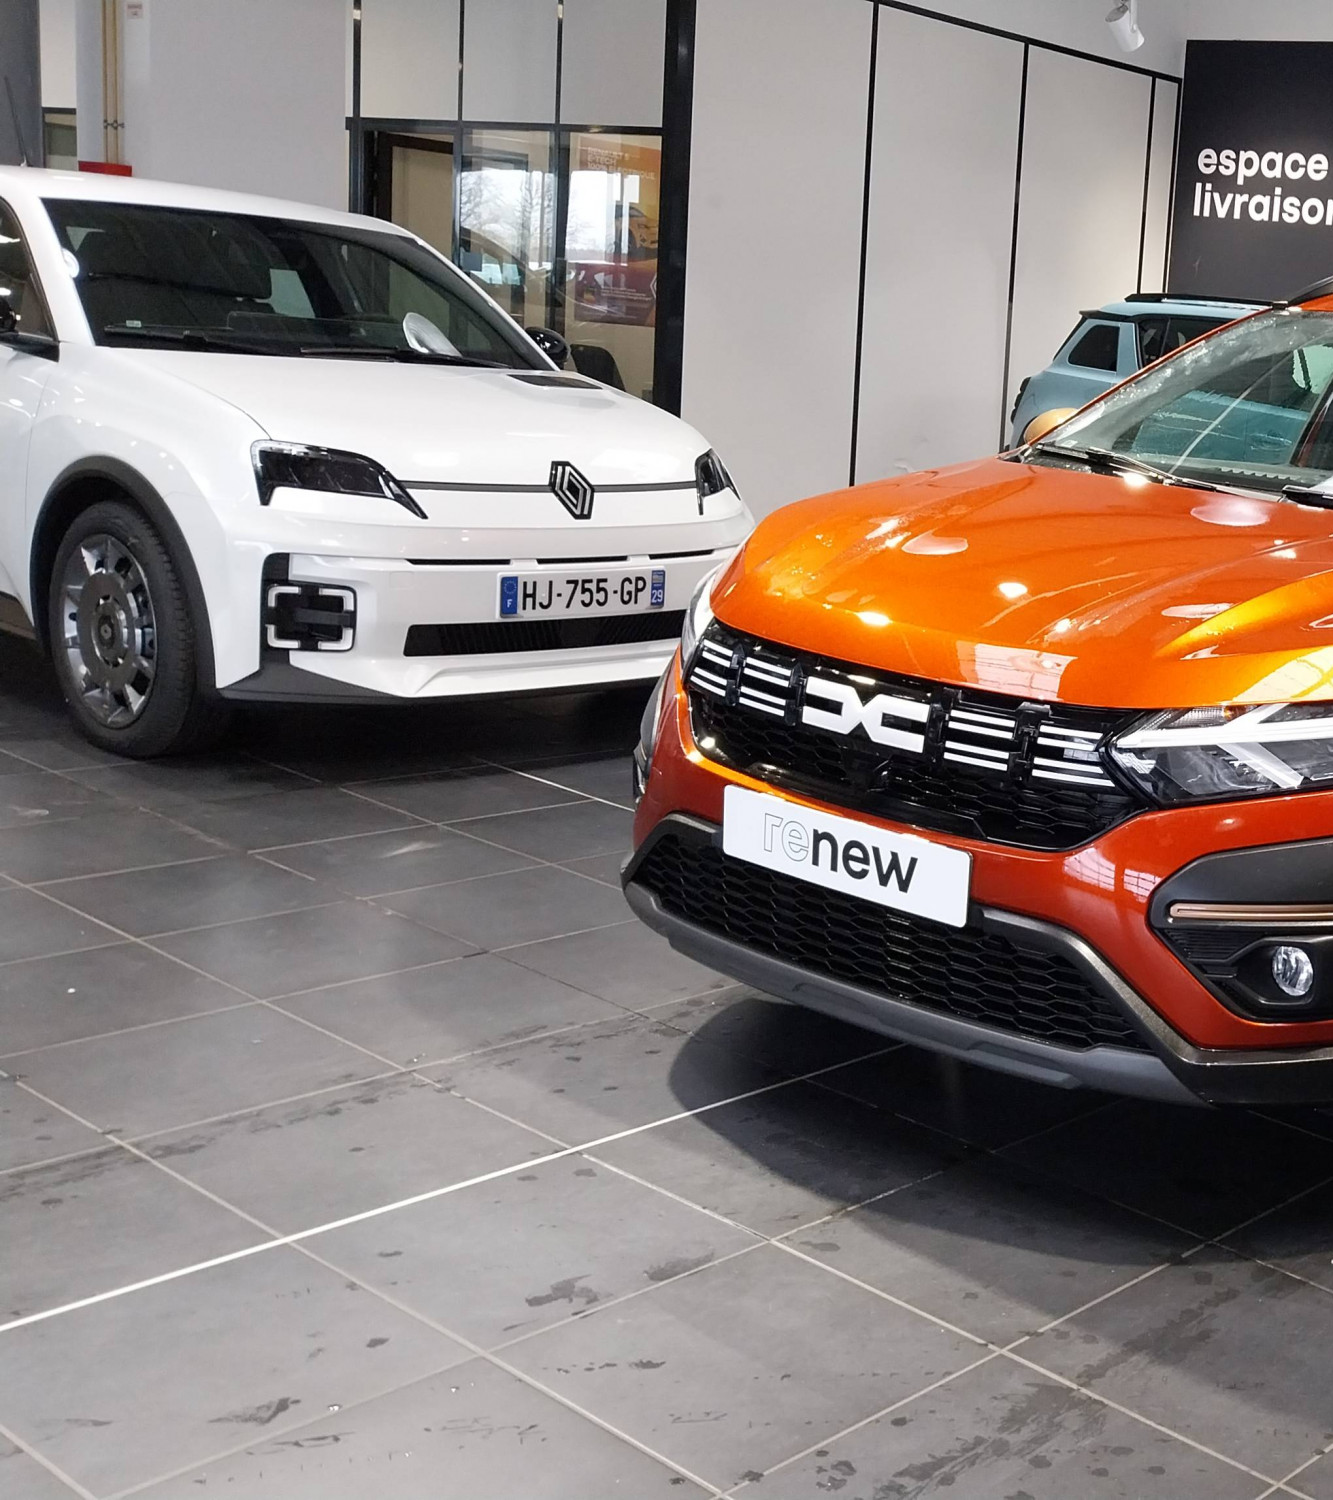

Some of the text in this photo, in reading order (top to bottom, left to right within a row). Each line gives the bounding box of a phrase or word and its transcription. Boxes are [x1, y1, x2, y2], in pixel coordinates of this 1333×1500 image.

[1197, 148, 1329, 185] espace
[506, 599, 512, 608] F
[522, 576, 647, 611] HJ-755-GP
[651, 589, 664, 603] 29
[763, 812, 919, 894] renew
